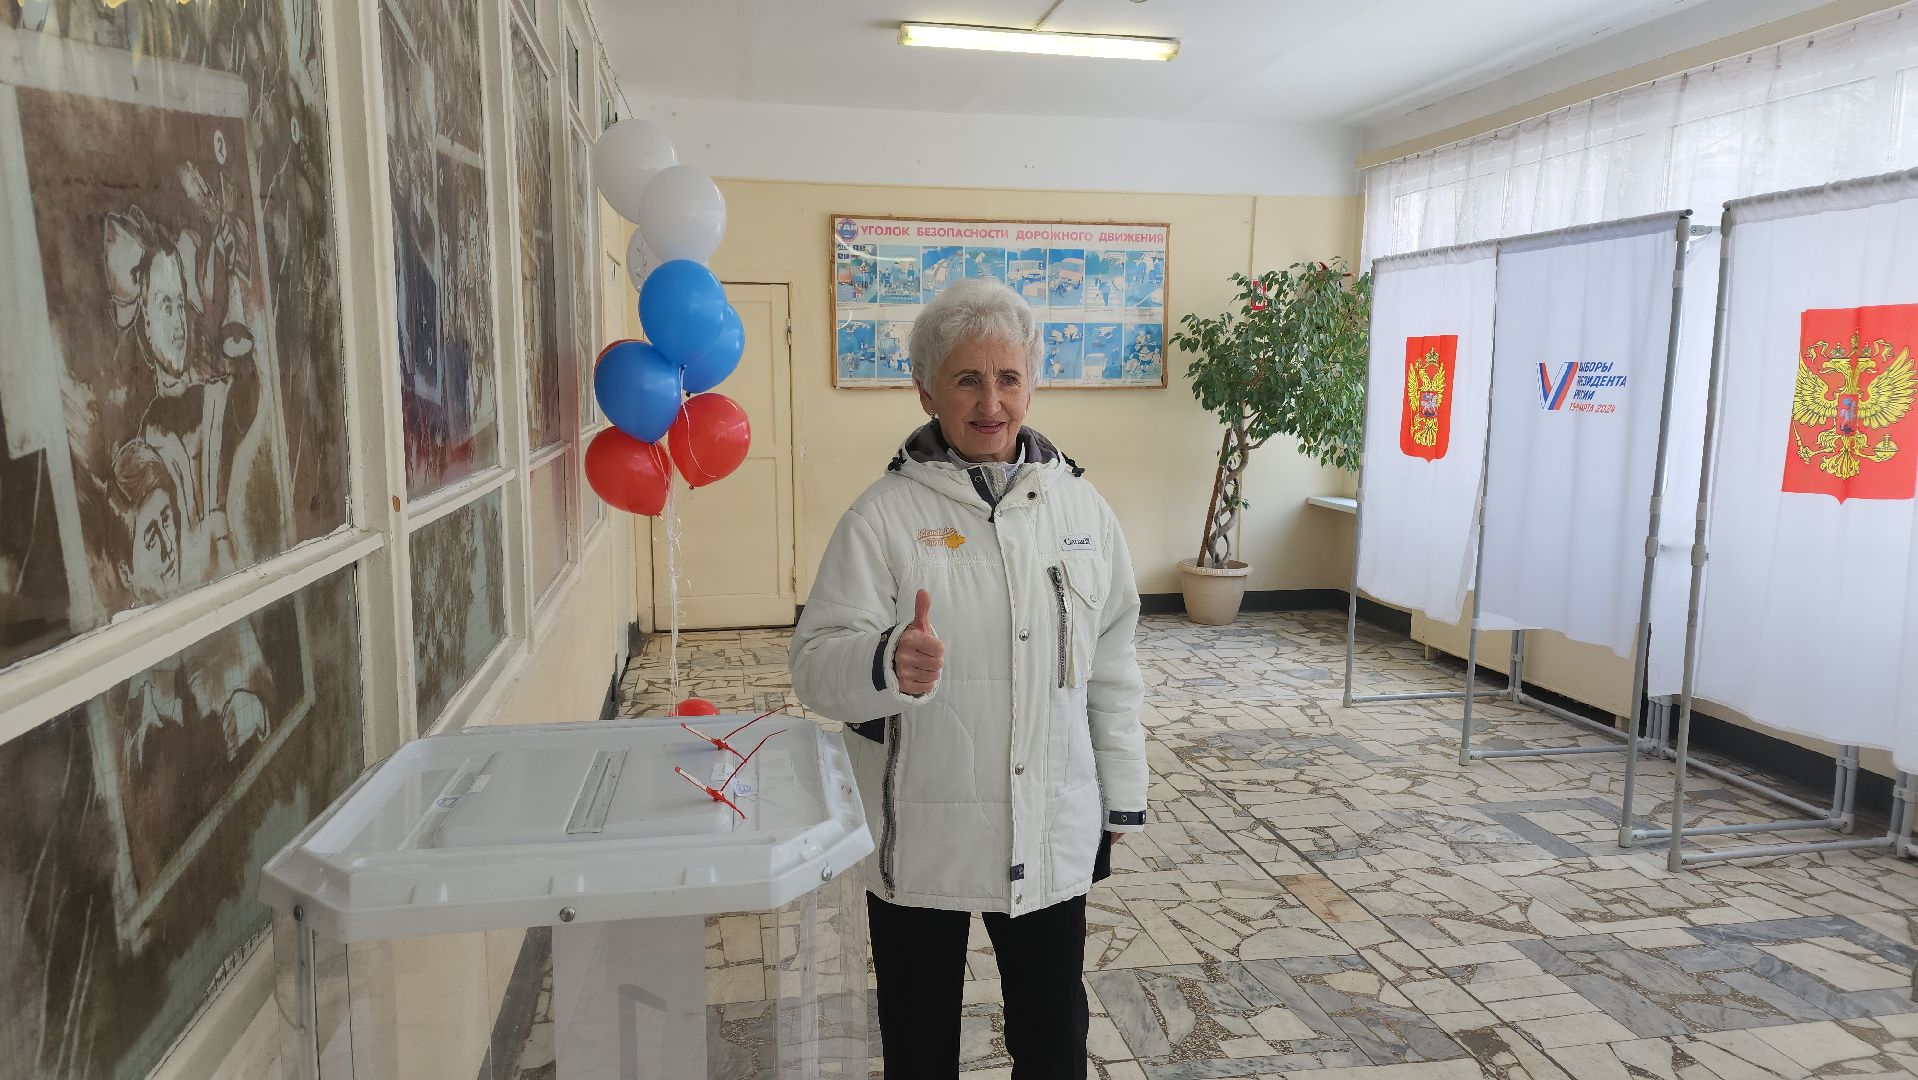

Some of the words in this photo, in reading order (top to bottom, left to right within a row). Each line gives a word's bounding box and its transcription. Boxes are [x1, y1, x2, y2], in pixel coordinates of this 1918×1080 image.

[860, 225, 910, 237] УГОЛОК
[917, 227, 1009, 239] БЕЗОПАСНОСТИ
[1015, 229, 1093, 241] ДОРОЖНОГО
[1098, 232, 1164, 244] ДВИЖЕНИЯ
[1595, 404, 1617, 413] 2024
